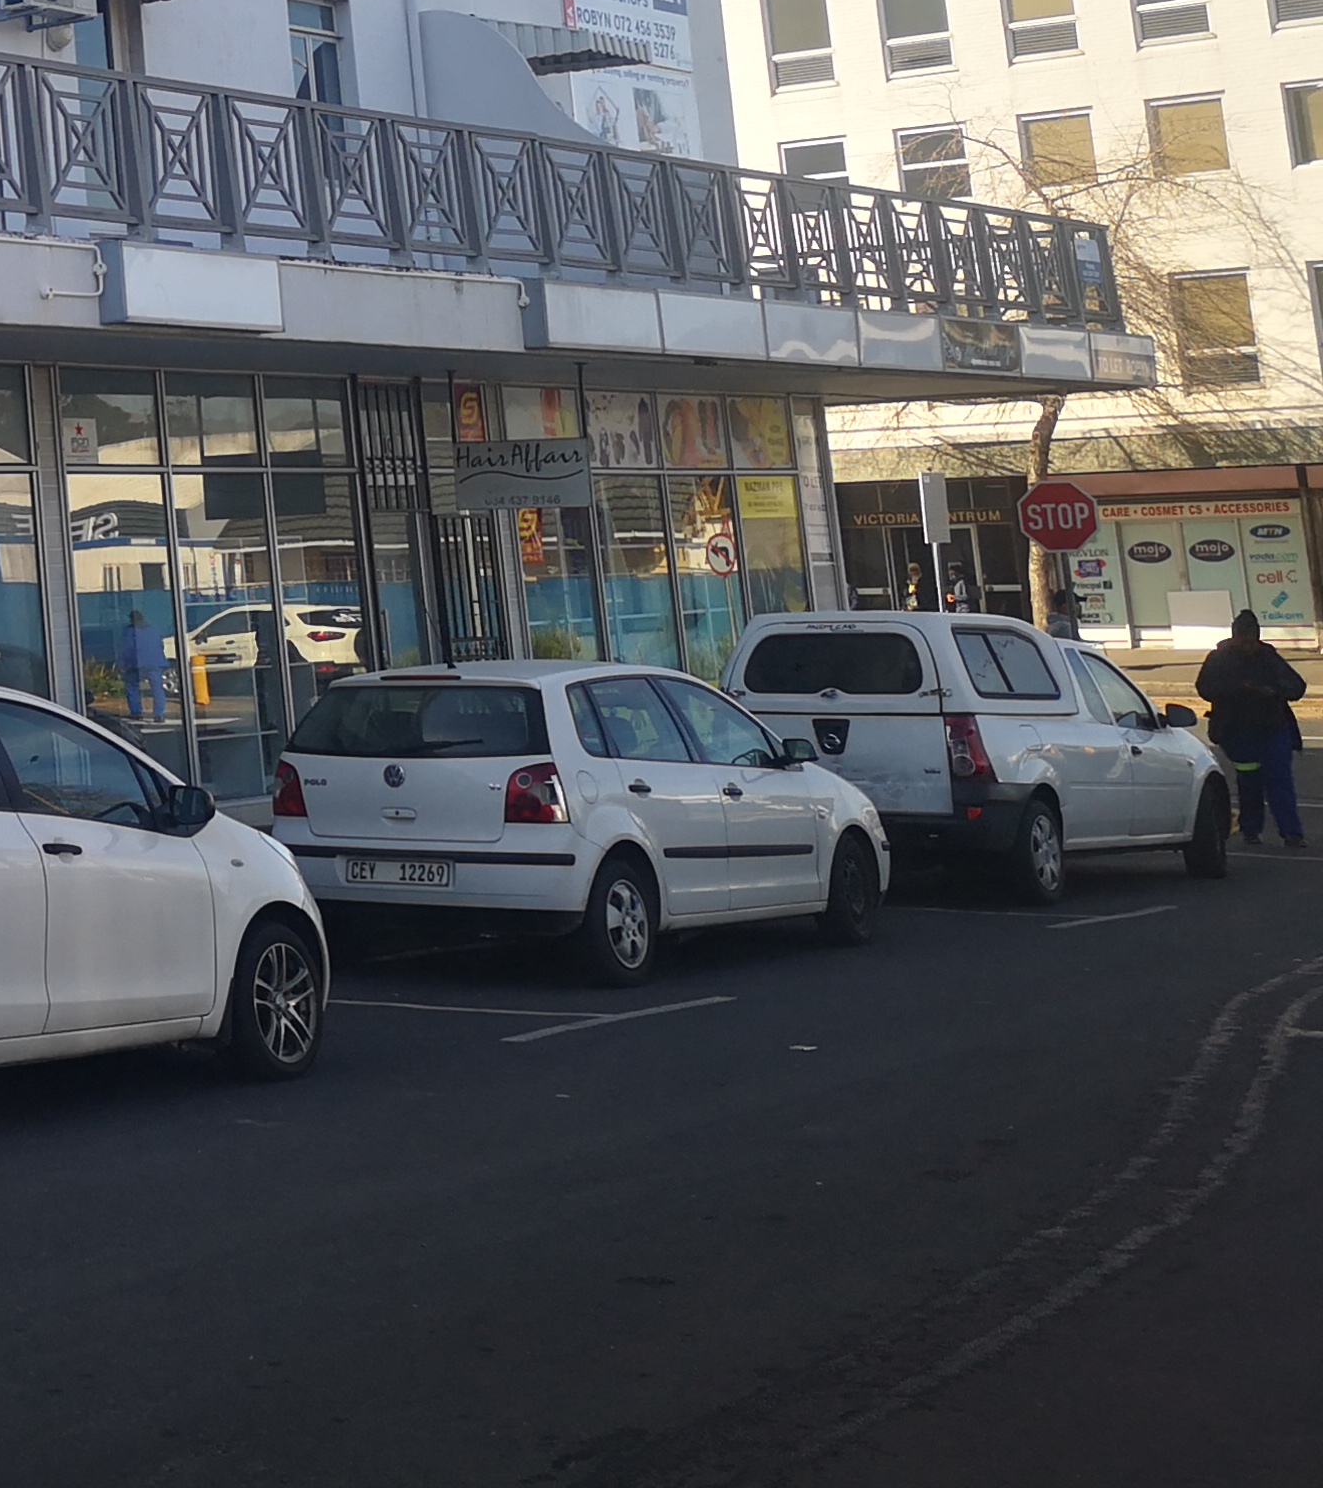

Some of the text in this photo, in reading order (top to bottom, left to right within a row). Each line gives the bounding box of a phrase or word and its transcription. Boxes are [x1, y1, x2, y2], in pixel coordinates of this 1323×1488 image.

[576, 7, 611, 29] ROBYN
[613, 13, 632, 33] 072
[635, 18, 652, 36] 456
[653, 22, 676, 41] 3539
[653, 44, 675, 60] 5276
[456, 443, 583, 473] Hair Affair
[1028, 502, 1089, 531] STOP
[1102, 506, 1130, 517] CARE
[1213, 502, 1290, 515] ACCESSORIES
[853, 512, 920, 525] VICTORIA
[1257, 528, 1283, 536] MTN
[1134, 543, 1167, 558] mojo
[1195, 541, 1229, 556] mojo
[1256, 570, 1283, 584] cell
[351, 862, 445, 883] CEY 12269
